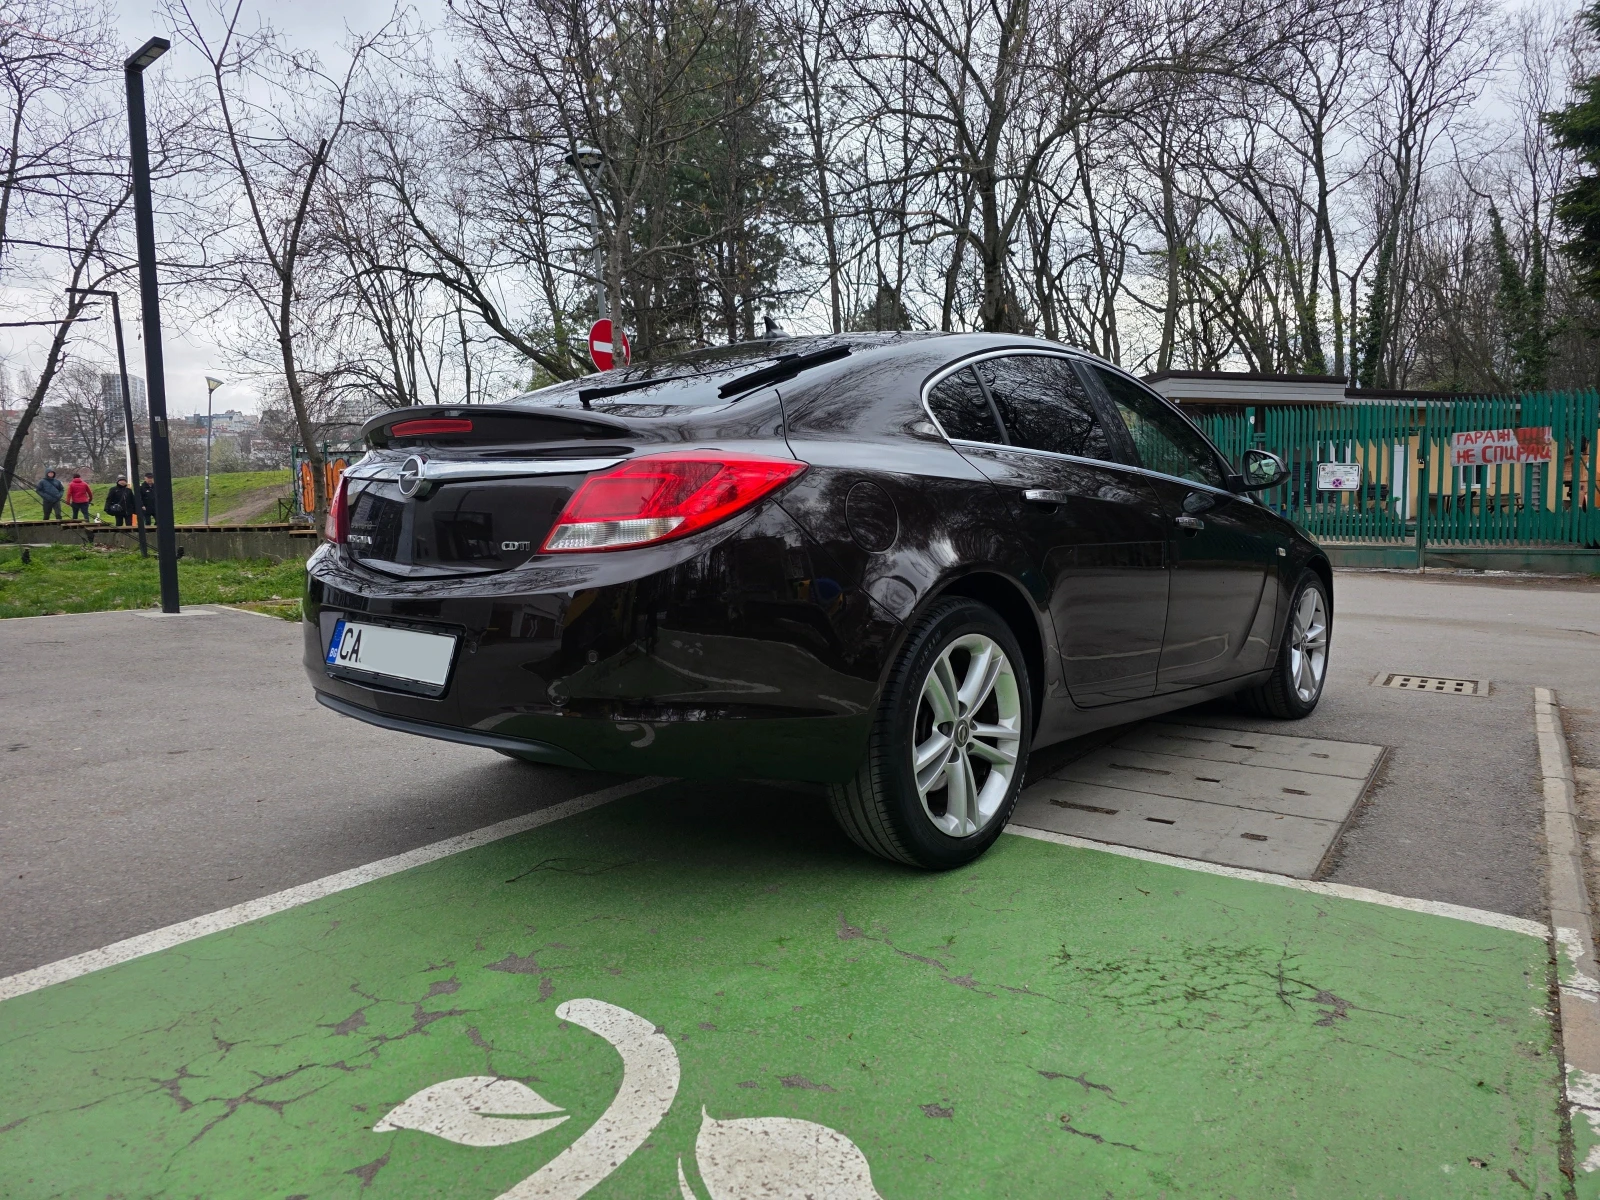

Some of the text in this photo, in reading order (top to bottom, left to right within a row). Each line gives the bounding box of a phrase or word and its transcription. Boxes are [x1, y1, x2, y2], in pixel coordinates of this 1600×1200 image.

[1456, 429, 1511, 446] ГАРАЖ
[1456, 448, 1476, 464] НЕ
[328, 647, 338, 658] BG
[340, 627, 362, 663] CA
